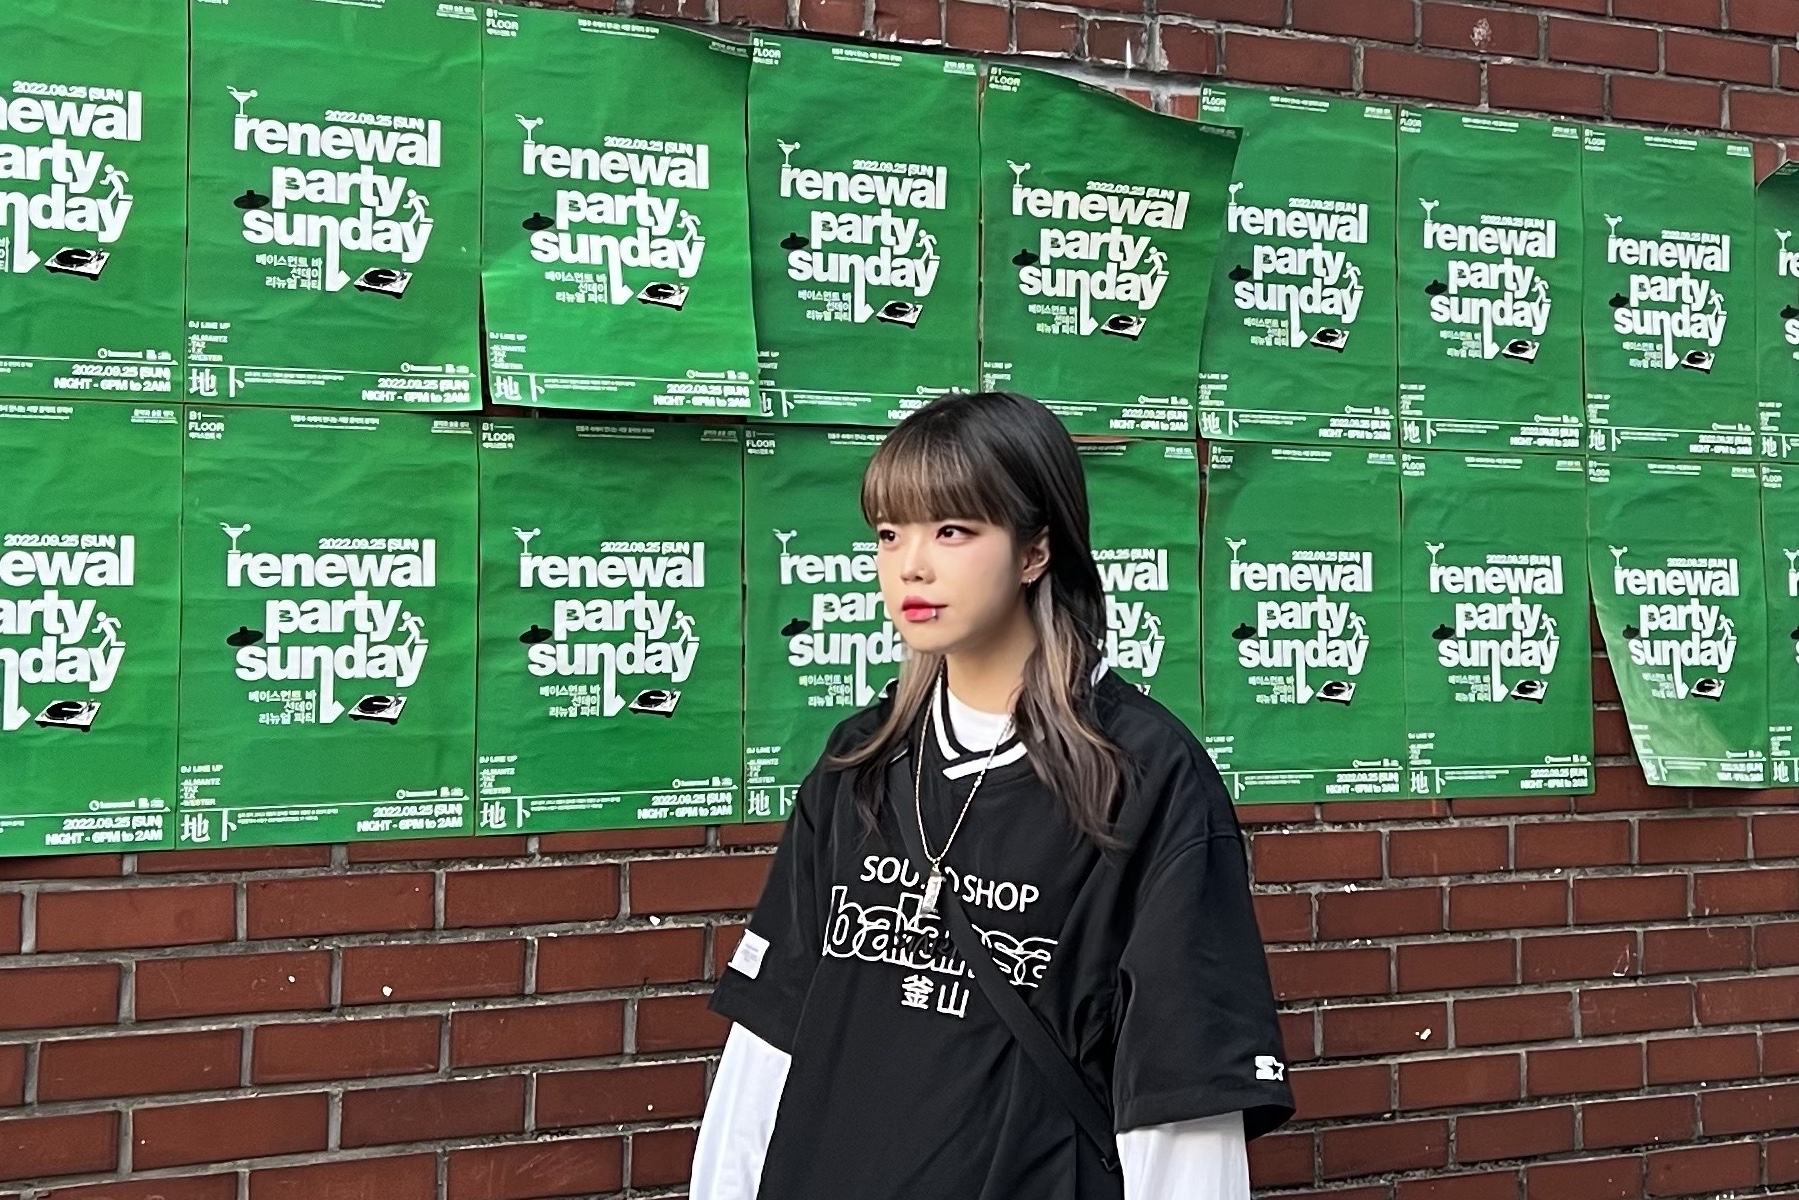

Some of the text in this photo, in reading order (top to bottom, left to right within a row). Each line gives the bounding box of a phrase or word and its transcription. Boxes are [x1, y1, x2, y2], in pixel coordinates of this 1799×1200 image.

[486, 19, 519, 31] FLOOR
[753, 47, 782, 59] FLOOR
[989, 76, 1021, 87] FLOOR
[0, 90, 142, 141] ewal
[325, 109, 392, 127] 2022.09.25
[233, 118, 441, 167] renewal
[0, 138, 104, 193] arty
[523, 144, 709, 189] renewal
[272, 165, 407, 217] party
[780, 166, 947, 210] renewal
[1012, 186, 1190, 229] renewal
[0, 183, 133, 243] nday
[556, 187, 680, 235] party
[810, 207, 919, 255] party
[1228, 203, 1368, 244] renewal
[242, 208, 433, 263] sunday
[530, 227, 705, 278] sunday
[1040, 226, 1151, 270] party
[1423, 219, 1556, 258] renewal
[1608, 235, 1730, 272] renewal
[787, 247, 940, 296] sunday
[1253, 242, 1345, 285] party
[1448, 257, 1534, 299] party
[1019, 263, 1168, 310] sunday
[1235, 278, 1363, 324] sunday
[1629, 272, 1709, 311] party
[1430, 291, 1551, 335] sunday
[1614, 304, 1727, 347] sunday
[54, 377, 92, 390] NIGHT
[129, 380, 142, 391] to
[143, 380, 171, 392] 2AM
[72, 364, 138, 377] 2022.09.25
[189, 411, 202, 420] B1
[189, 422, 225, 432] FLOOR
[482, 433, 515, 442] FLOOR
[746, 439, 776, 448] FLOOR
[0, 535, 135, 587] ewal
[4, 534, 116, 549] 2022.09.25 (SUN)
[226, 539, 436, 587] renewal
[319, 537, 419, 553] 2022.09.25 (SUN)
[520, 542, 705, 588] renewal
[780, 553, 879, 585] rene
[1230, 552, 1372, 592] renewal
[1429, 555, 1563, 594] renewal
[1614, 558, 1739, 597] renewal
[0, 589, 97, 645] arty
[265, 590, 402, 643] party
[554, 590, 676, 641] party
[812, 592, 892, 630] par
[1258, 594, 1349, 637] party
[1455, 596, 1543, 638] party
[1639, 598, 1720, 639] party
[0, 636, 125, 693] nday
[235, 633, 428, 688] sunday
[527, 632, 700, 683] sunday
[788, 621, 915, 667] sunda
[1238, 631, 1369, 675] sunday
[1438, 631, 1560, 675] sunday
[1628, 632, 1737, 674] sunday
[63, 815, 163, 830] 2022.09.25 (SUN)
[181, 809, 237, 842] 地下
[357, 820, 392, 832] NIGHT
[425, 819, 437, 829] to
[437, 817, 463, 828] 2AM
[373, 805, 433, 818] 2022.09.25
[637, 808, 669, 819] NIGHT
[45, 829, 163, 845] NIGHT 6PM to 2AM
[860, 855, 1039, 913] SOU SHOP
[901, 974, 970, 1018] 釜山
